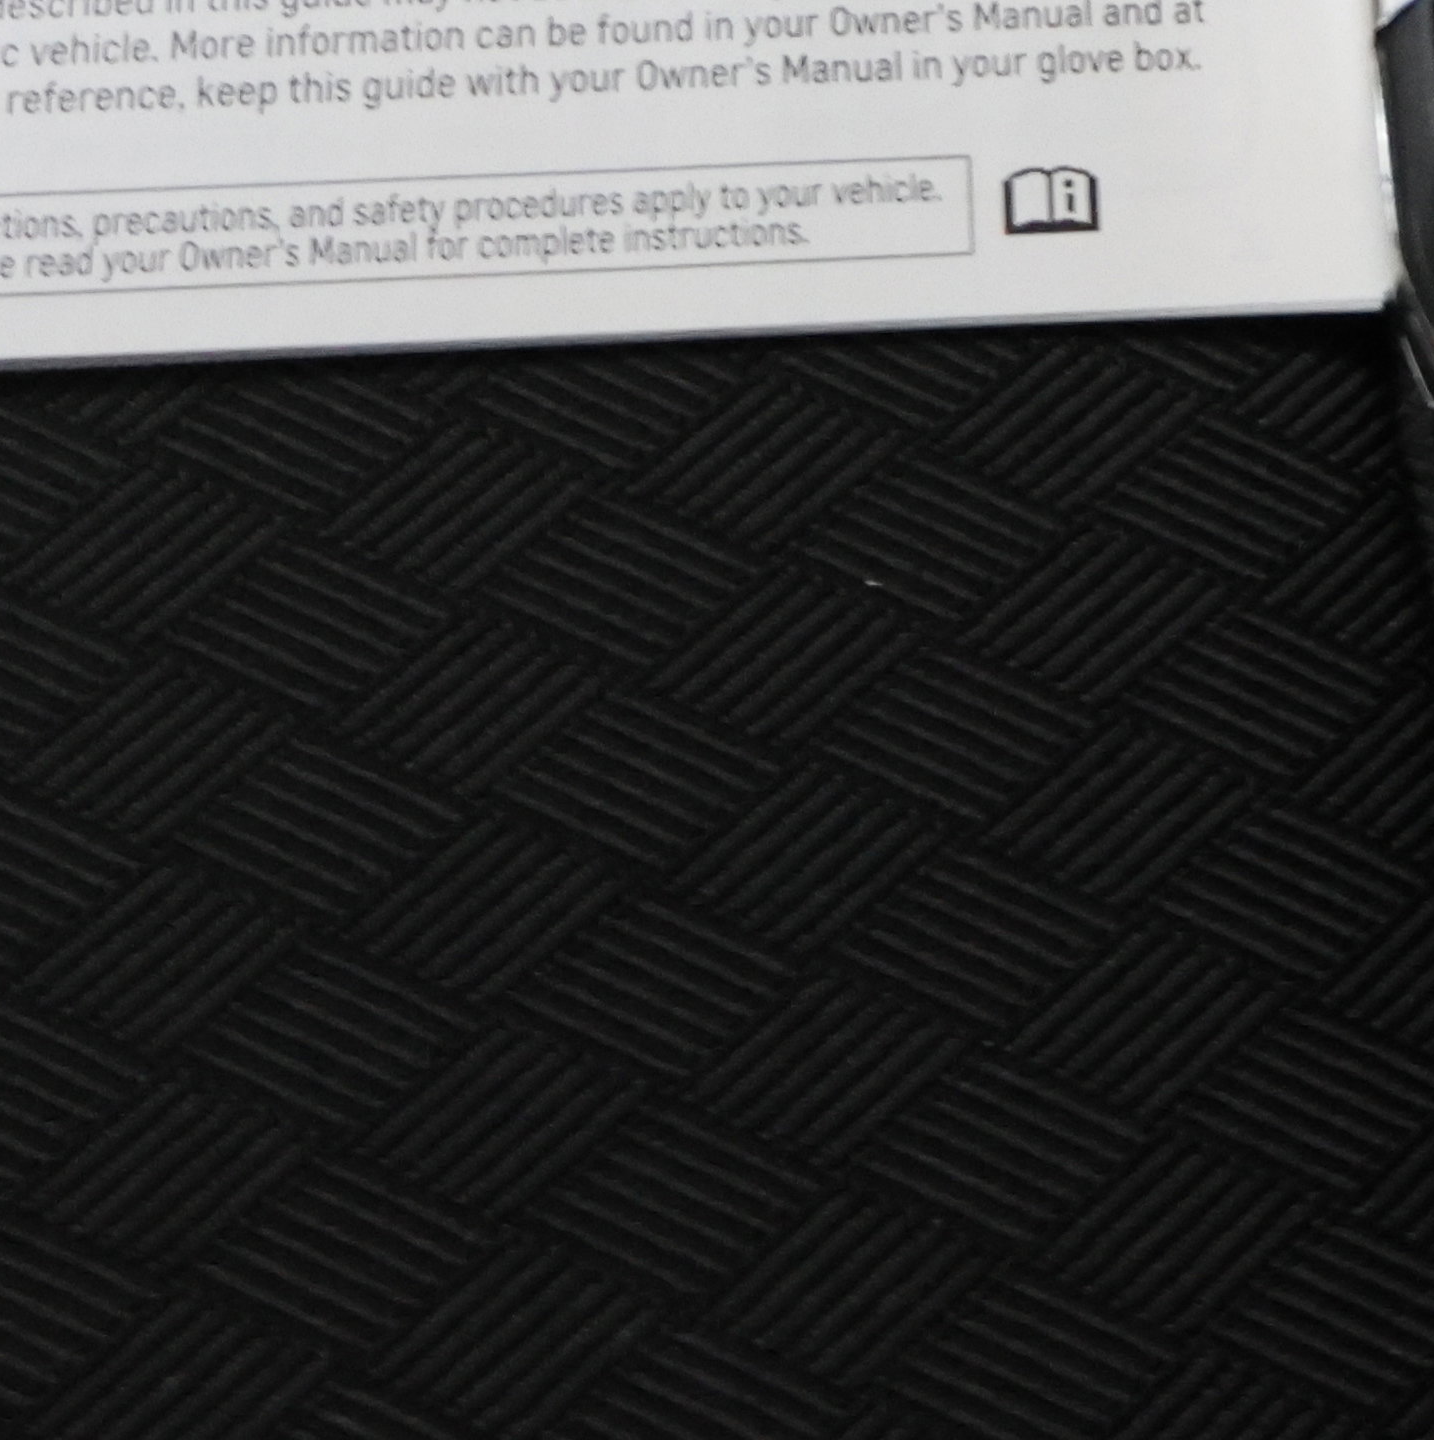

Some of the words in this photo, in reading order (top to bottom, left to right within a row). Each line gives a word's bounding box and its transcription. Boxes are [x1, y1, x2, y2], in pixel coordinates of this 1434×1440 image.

[30, 32, 159, 67] vehicle.
[170, 29, 256, 61] More
[266, 21, 465, 58] information
[474, 23, 536, 50] can
[546, 15, 587, 48] be
[596, 10, 694, 46] found
[704, 11, 734, 41] in
[743, 13, 820, 49] your
[829, 3, 964, 38] Owner's
[7, 81, 185, 114] reference,
[196, 75, 278, 114] keep
[288, 71, 351, 104] this
[363, 67, 456, 111] guide
[465, 63, 540, 97] with
[549, 67, 626, 103] your
[635, 55, 772, 91] Owner's
[781, 50, 903, 84] Manual
[912, 50, 943, 80] in
[951, 52, 1027, 87] your
[1036, 43, 1125, 85] glove
[1133, 40, 1202, 73] box.
[288, 196, 344, 229] and
[353, 193, 444, 233] safety
[454, 188, 624, 229] procedures
[633, 182, 711, 221] apply
[720, 184, 750, 210] to
[757, 182, 823, 216] your
[832, 174, 942, 205] vehicle.
[24, 245, 94, 278] read
[102, 249, 170, 283] your
[179, 238, 300, 272] Owner's
[310, 233, 416, 267] Manual
[427, 230, 469, 262] for
[478, 226, 616, 264] complete
[624, 221, 809, 252] instructions.
